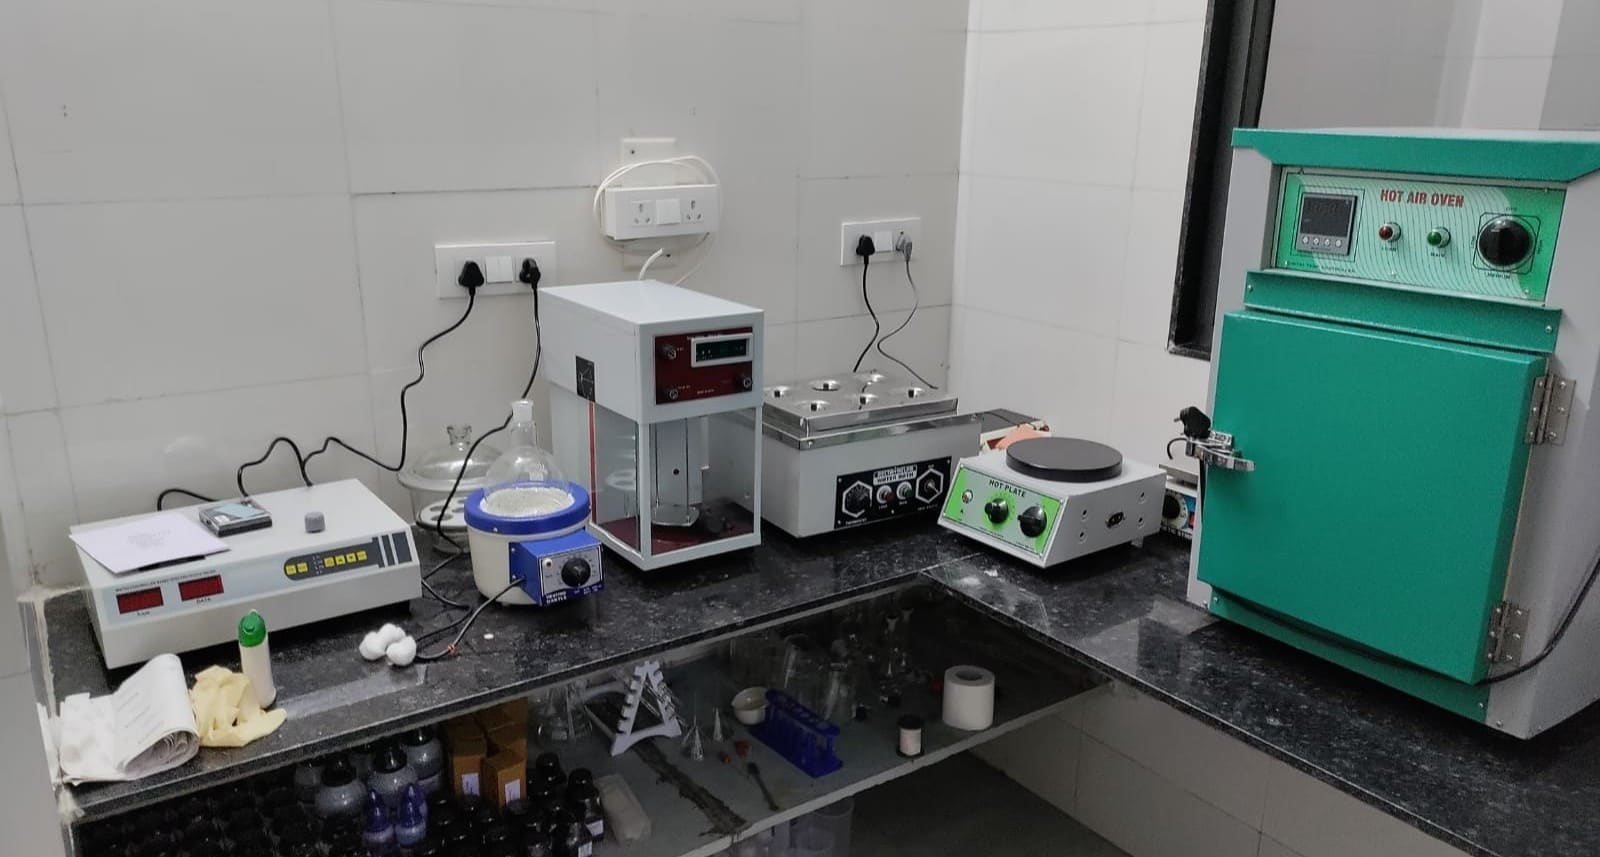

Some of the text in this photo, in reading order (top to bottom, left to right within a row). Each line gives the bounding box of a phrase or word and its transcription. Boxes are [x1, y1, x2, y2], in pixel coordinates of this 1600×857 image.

[1380, 189, 1464, 208] HOT AIR OVEN
[989, 479, 1027, 498] HOT PLATE
